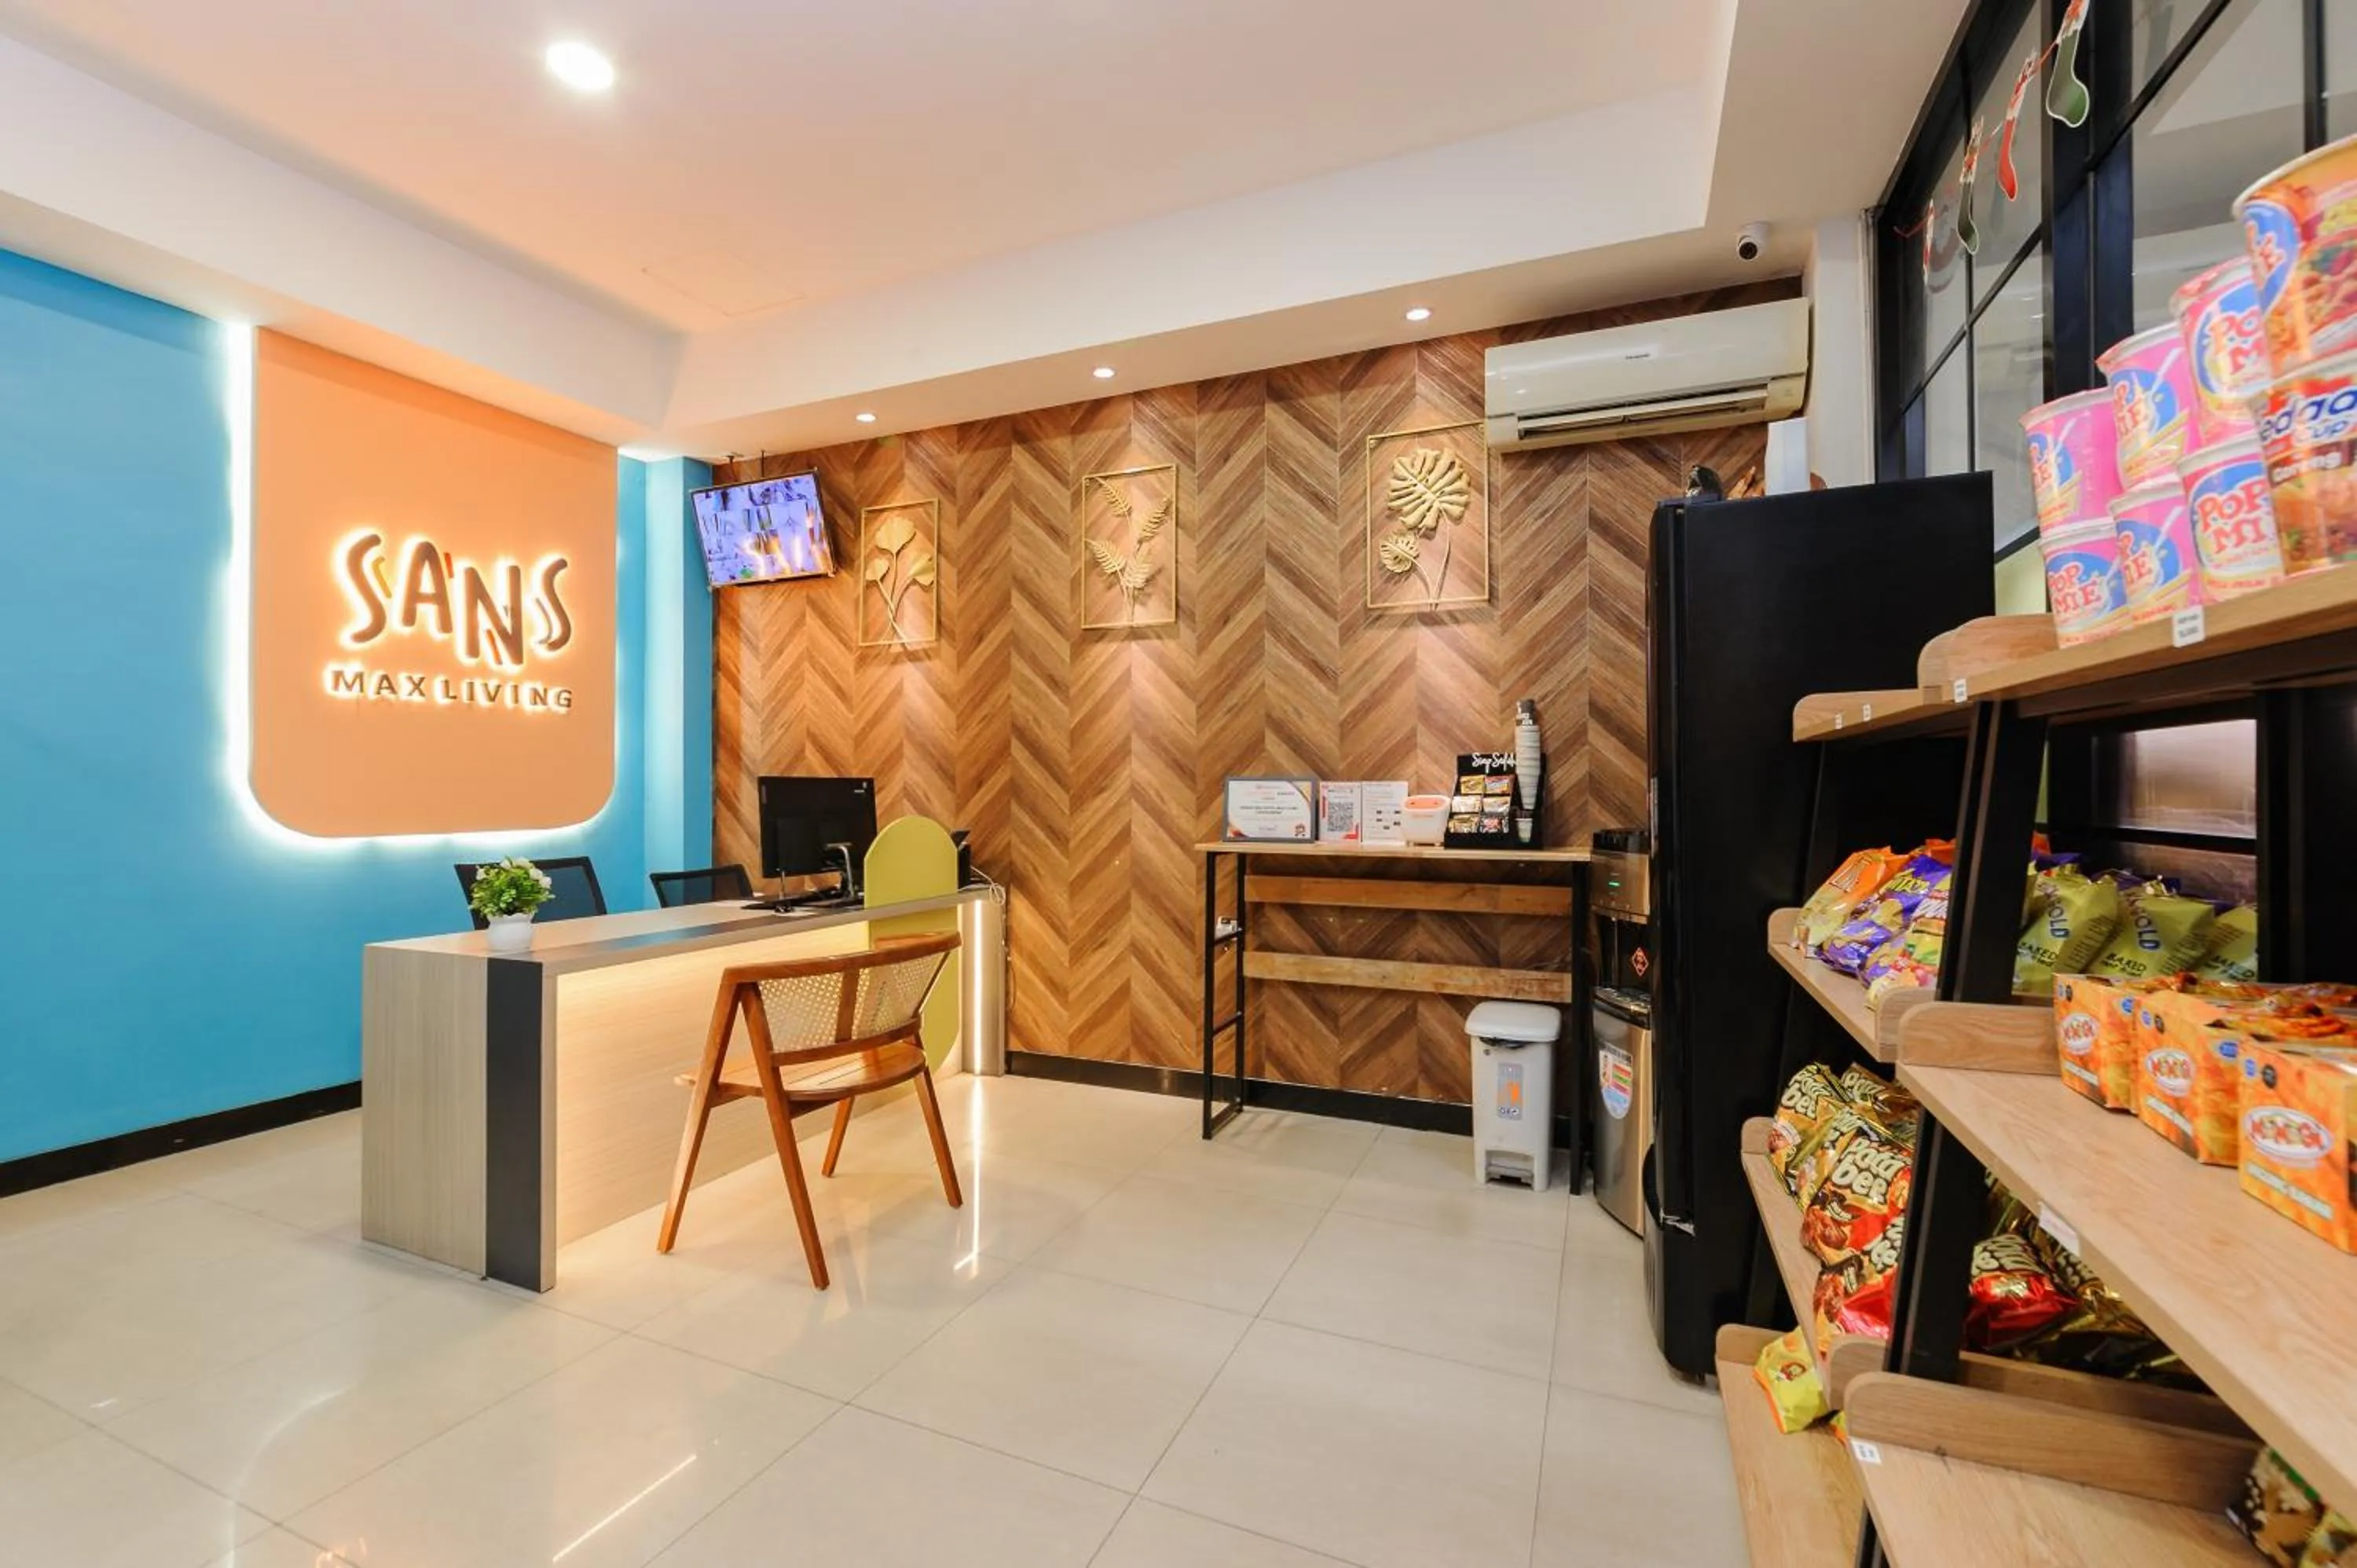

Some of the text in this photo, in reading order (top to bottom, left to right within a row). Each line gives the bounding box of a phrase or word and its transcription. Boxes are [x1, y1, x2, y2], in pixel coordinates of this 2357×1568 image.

[2209, 309, 2264, 355] PO
[2196, 479, 2267, 533] POP
[2211, 518, 2266, 554] MI
[346, 534, 572, 665] SANS
[331, 669, 573, 708] MAX LIVING
